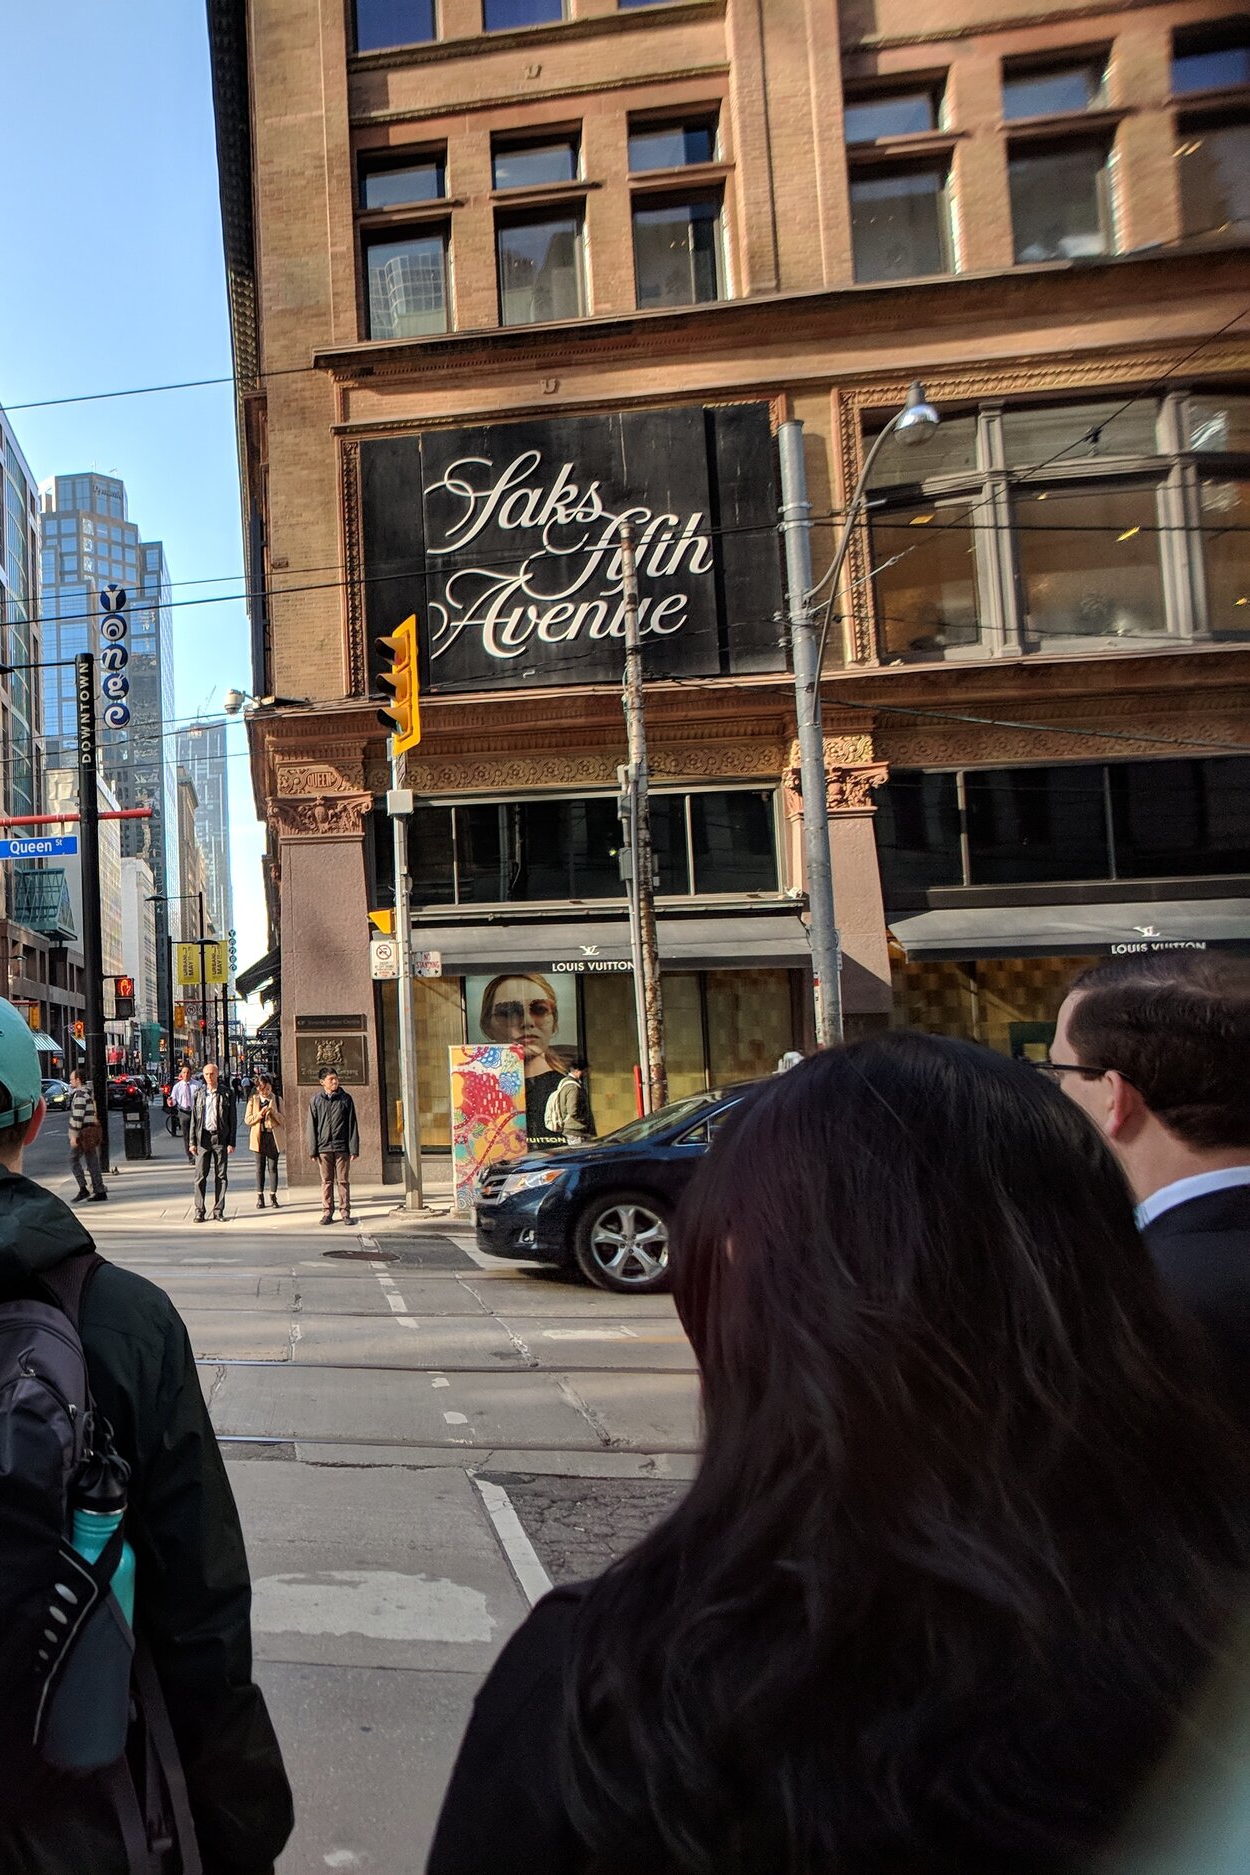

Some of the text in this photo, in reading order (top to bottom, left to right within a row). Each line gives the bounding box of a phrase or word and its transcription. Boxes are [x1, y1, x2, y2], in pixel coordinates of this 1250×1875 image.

[424, 450, 603, 555] Saks
[101, 584, 130, 729] Yonge
[429, 568, 688, 660] Avenue
[79, 662, 92, 764] DOWNTOWN
[10, 838, 63, 854] Queen St
[552, 961, 635, 972] LOUIS VUITTON
[1111, 942, 1206, 955] LOUIS VUITTON
